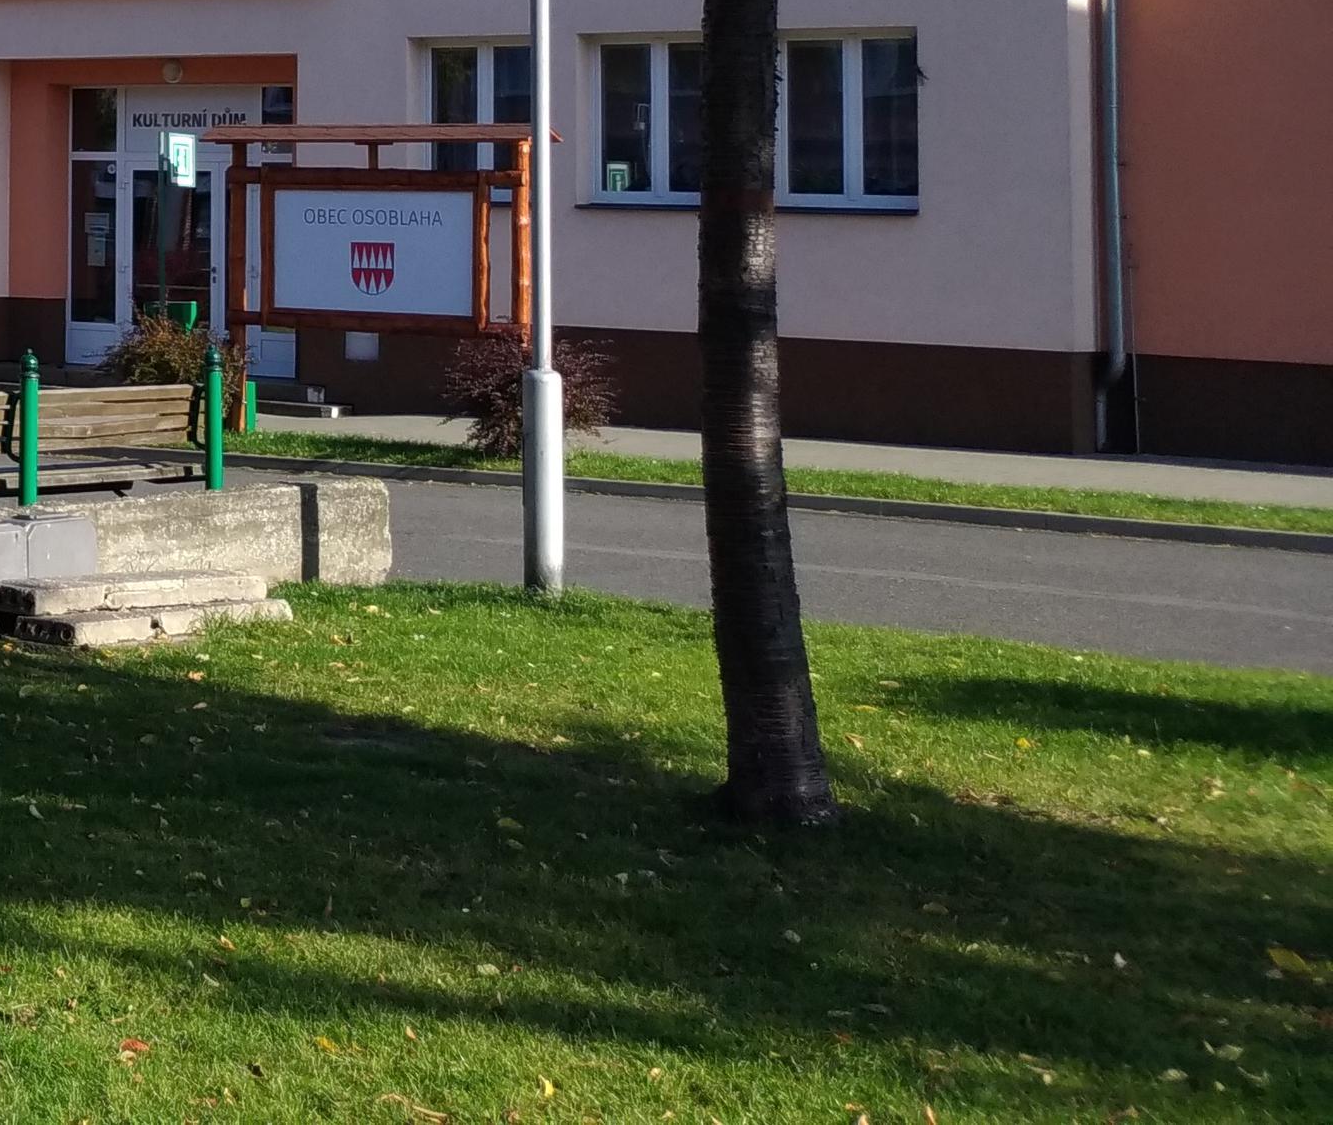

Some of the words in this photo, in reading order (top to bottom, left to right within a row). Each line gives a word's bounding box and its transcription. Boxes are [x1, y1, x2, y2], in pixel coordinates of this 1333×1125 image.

[132, 108, 208, 128] KULTURNÍ
[211, 107, 247, 126] DŮM
[304, 208, 347, 225] OBEC
[352, 209, 443, 226] OSOBLAHA
